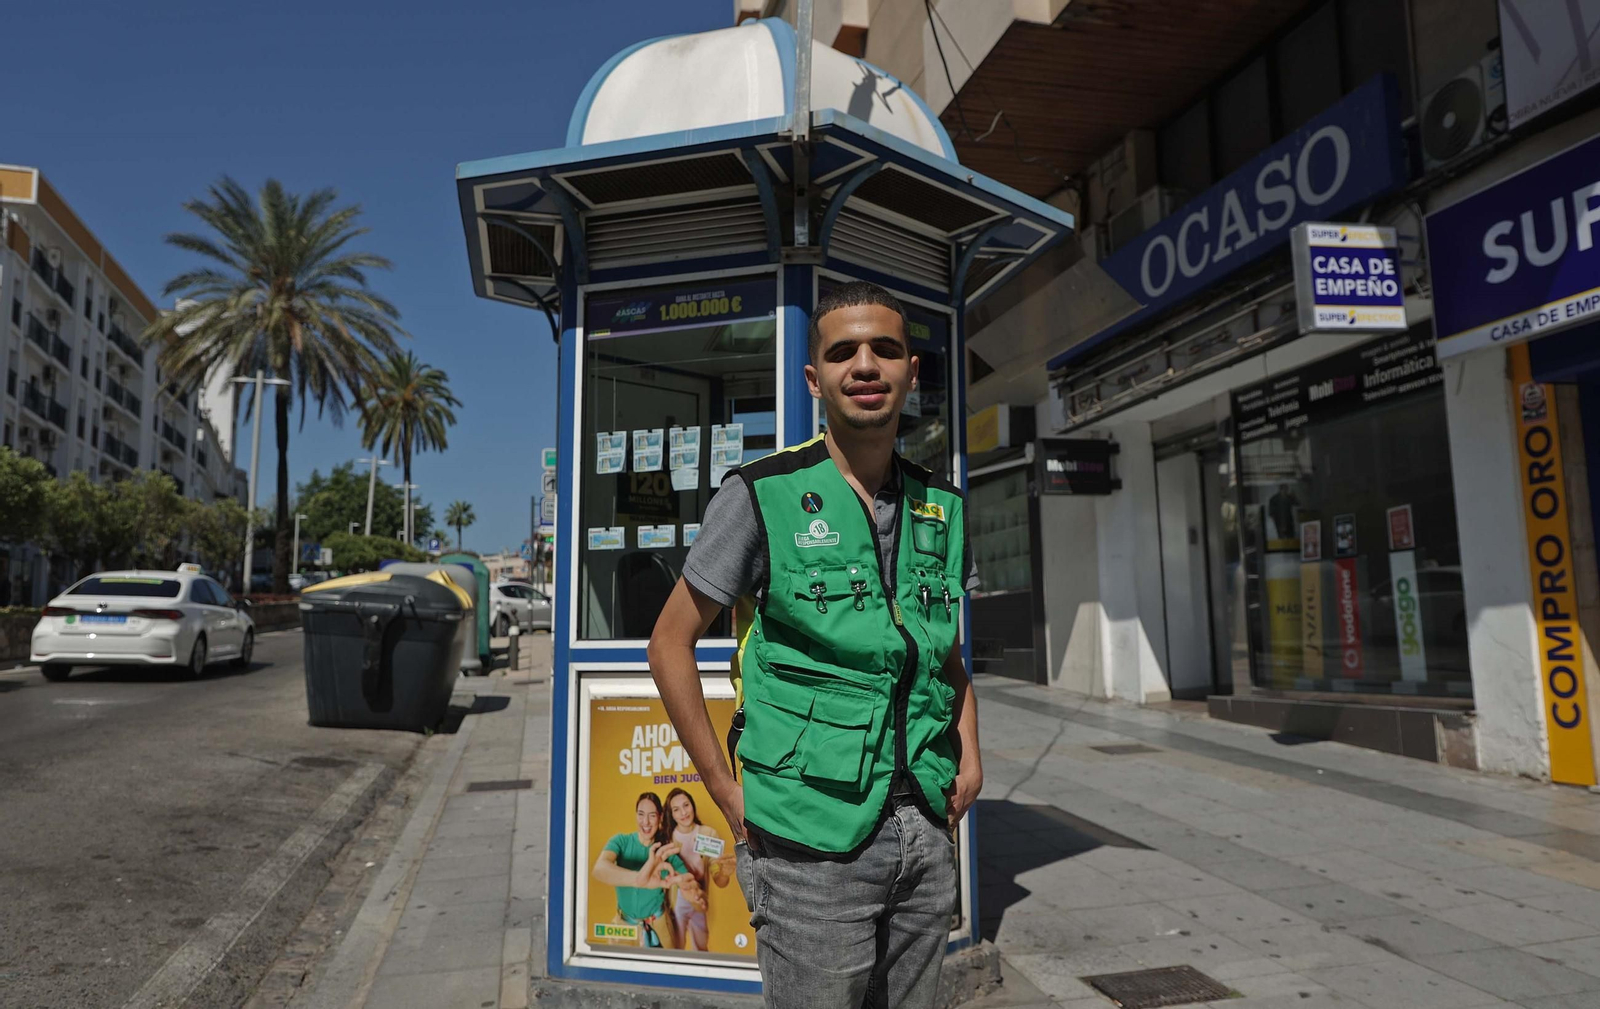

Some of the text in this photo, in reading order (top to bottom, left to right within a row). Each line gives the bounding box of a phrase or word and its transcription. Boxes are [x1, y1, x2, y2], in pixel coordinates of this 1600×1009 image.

[1141, 125, 1350, 297] OCASO
[1311, 229, 1339, 239] SUPER
[1313, 256, 1396, 275] CASA DE
[1315, 276, 1398, 297] EMPEÑO
[616, 306, 646, 317] RASCAS
[660, 296, 742, 321] 1.000.000 €
[1319, 312, 1400, 323] SUPER EFECTIVO
[1490, 295, 1600, 341] CASA DE EMP
[1363, 355, 1434, 389] Informática
[628, 472, 670, 497] 120
[1525, 426, 1560, 520] ORO
[1341, 569, 1355, 645] vodafone
[1397, 577, 1419, 656] yoigo
[1535, 534, 1582, 729] COMPRO
[654, 775, 678, 784] BIEN
[607, 927, 634, 936] ONCE
